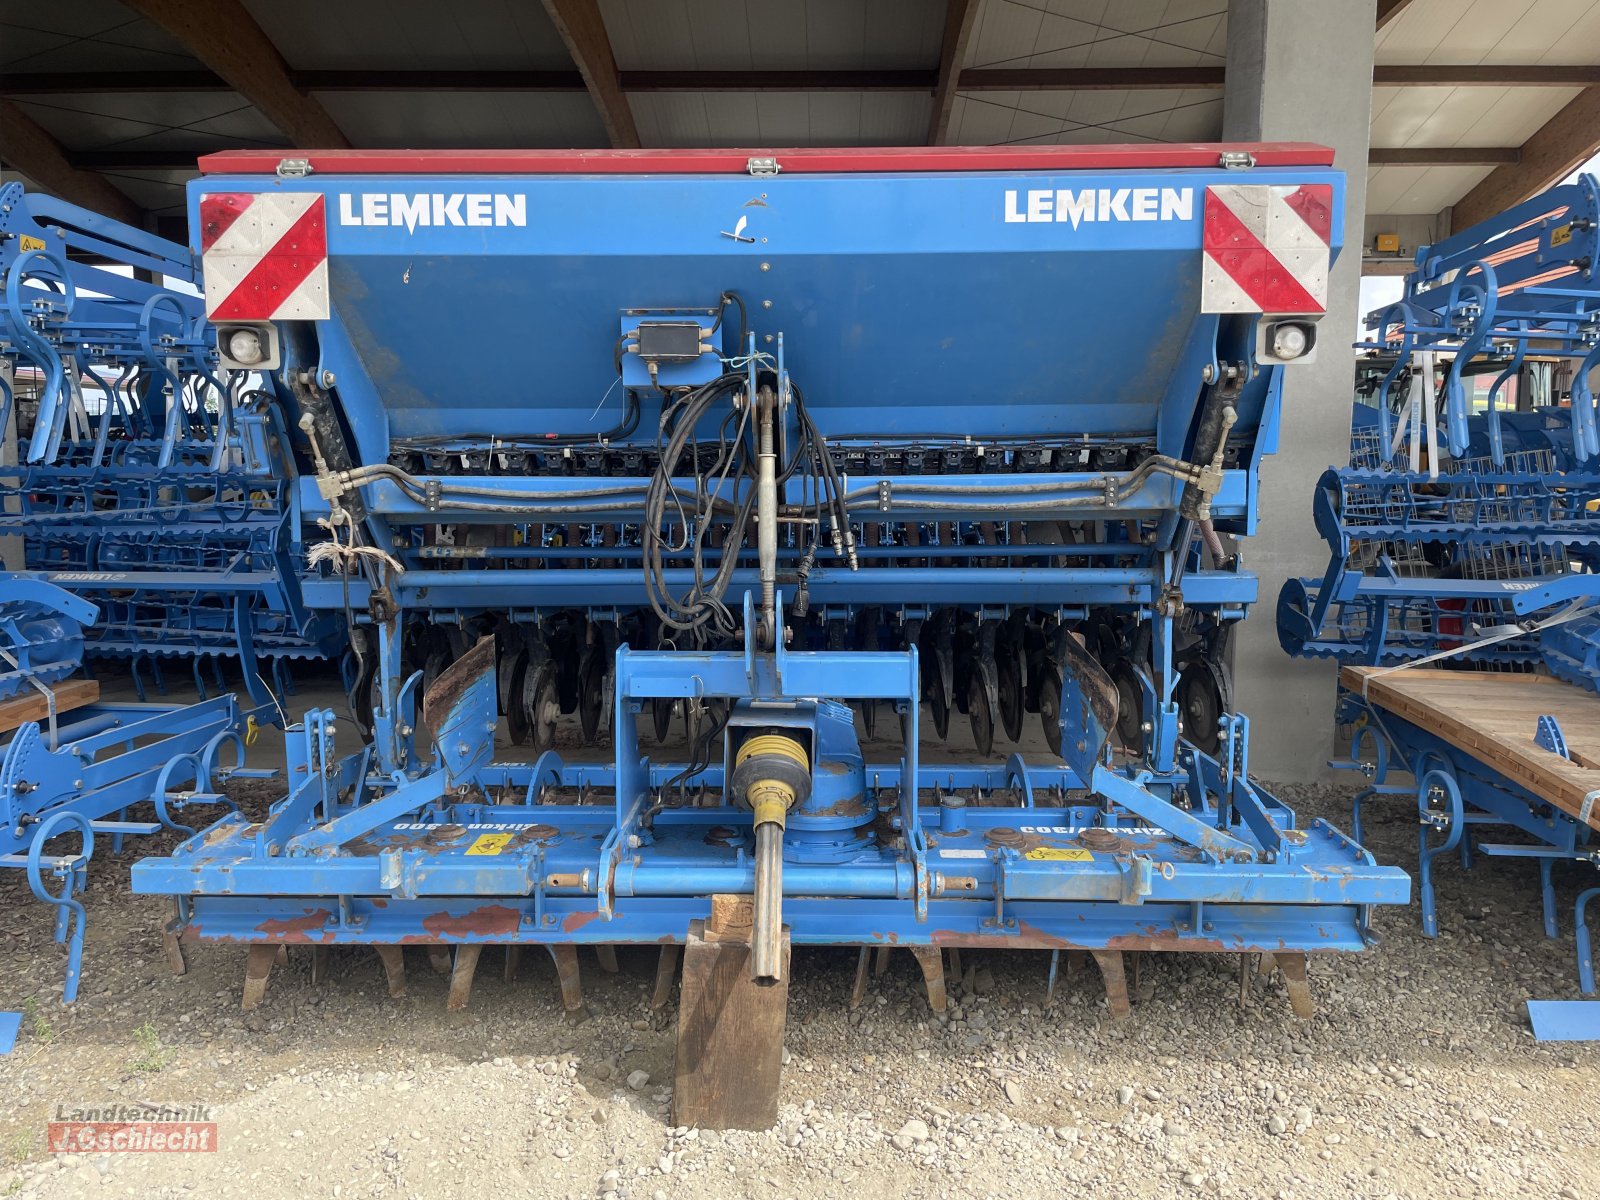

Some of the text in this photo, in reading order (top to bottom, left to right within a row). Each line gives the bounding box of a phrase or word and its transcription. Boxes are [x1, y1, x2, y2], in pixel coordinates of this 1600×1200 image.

[339, 193, 527, 236] LEMKEN
[1004, 187, 1194, 232] LEMKEN
[1501, 582, 1542, 590] KEN
[467, 823, 539, 831] Zirkon
[1091, 826, 1167, 836] Zirko
